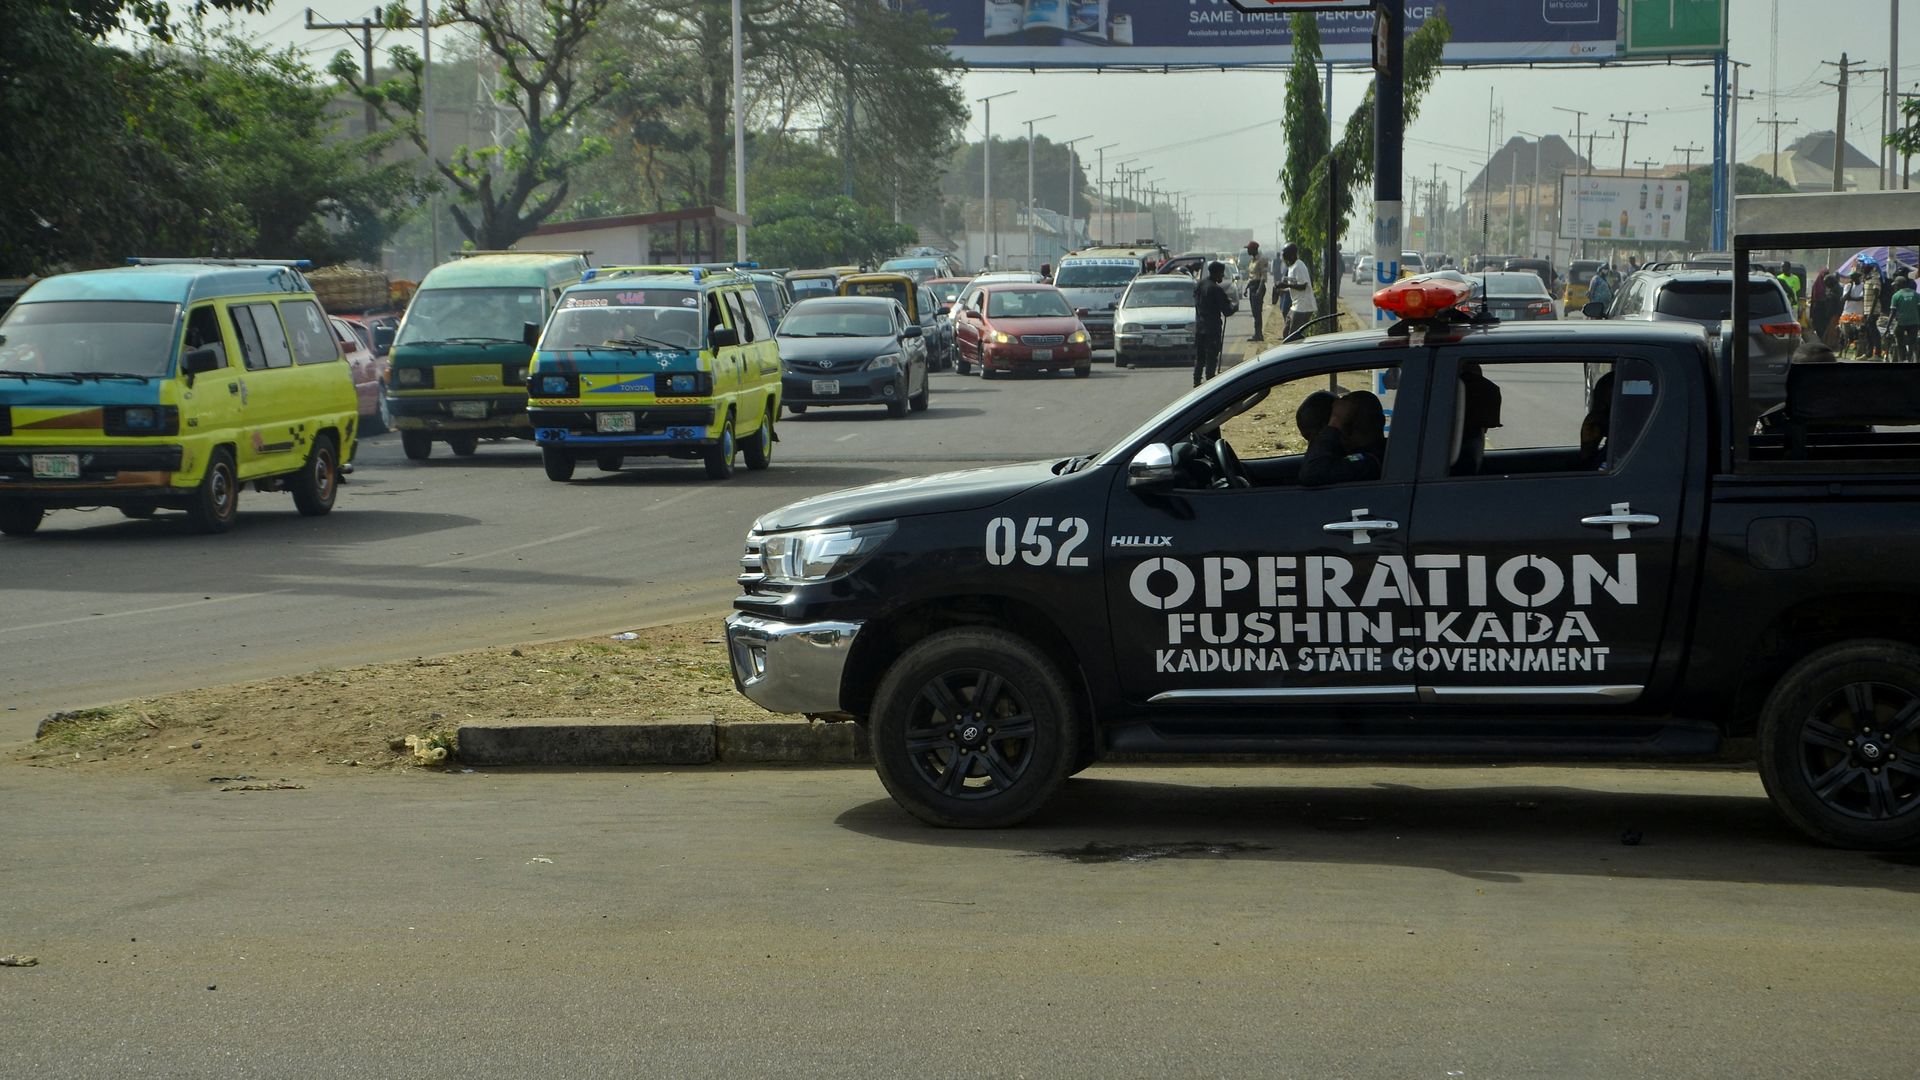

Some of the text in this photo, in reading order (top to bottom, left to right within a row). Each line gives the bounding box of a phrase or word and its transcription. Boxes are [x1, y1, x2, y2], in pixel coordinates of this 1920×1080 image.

[1189, 10, 1234, 23] SAME
[1237, 11, 1292, 22] TIMELE
[620, 384, 649, 392] TOYOTA
[985, 517, 1089, 567] 052
[1111, 535, 1173, 547] HILUX
[1129, 553, 1638, 610] OPERATION
[1168, 611, 1600, 644] FUSHIN-KADA
[1156, 647, 1610, 673] KADUNA STATE GOVERNMENT
